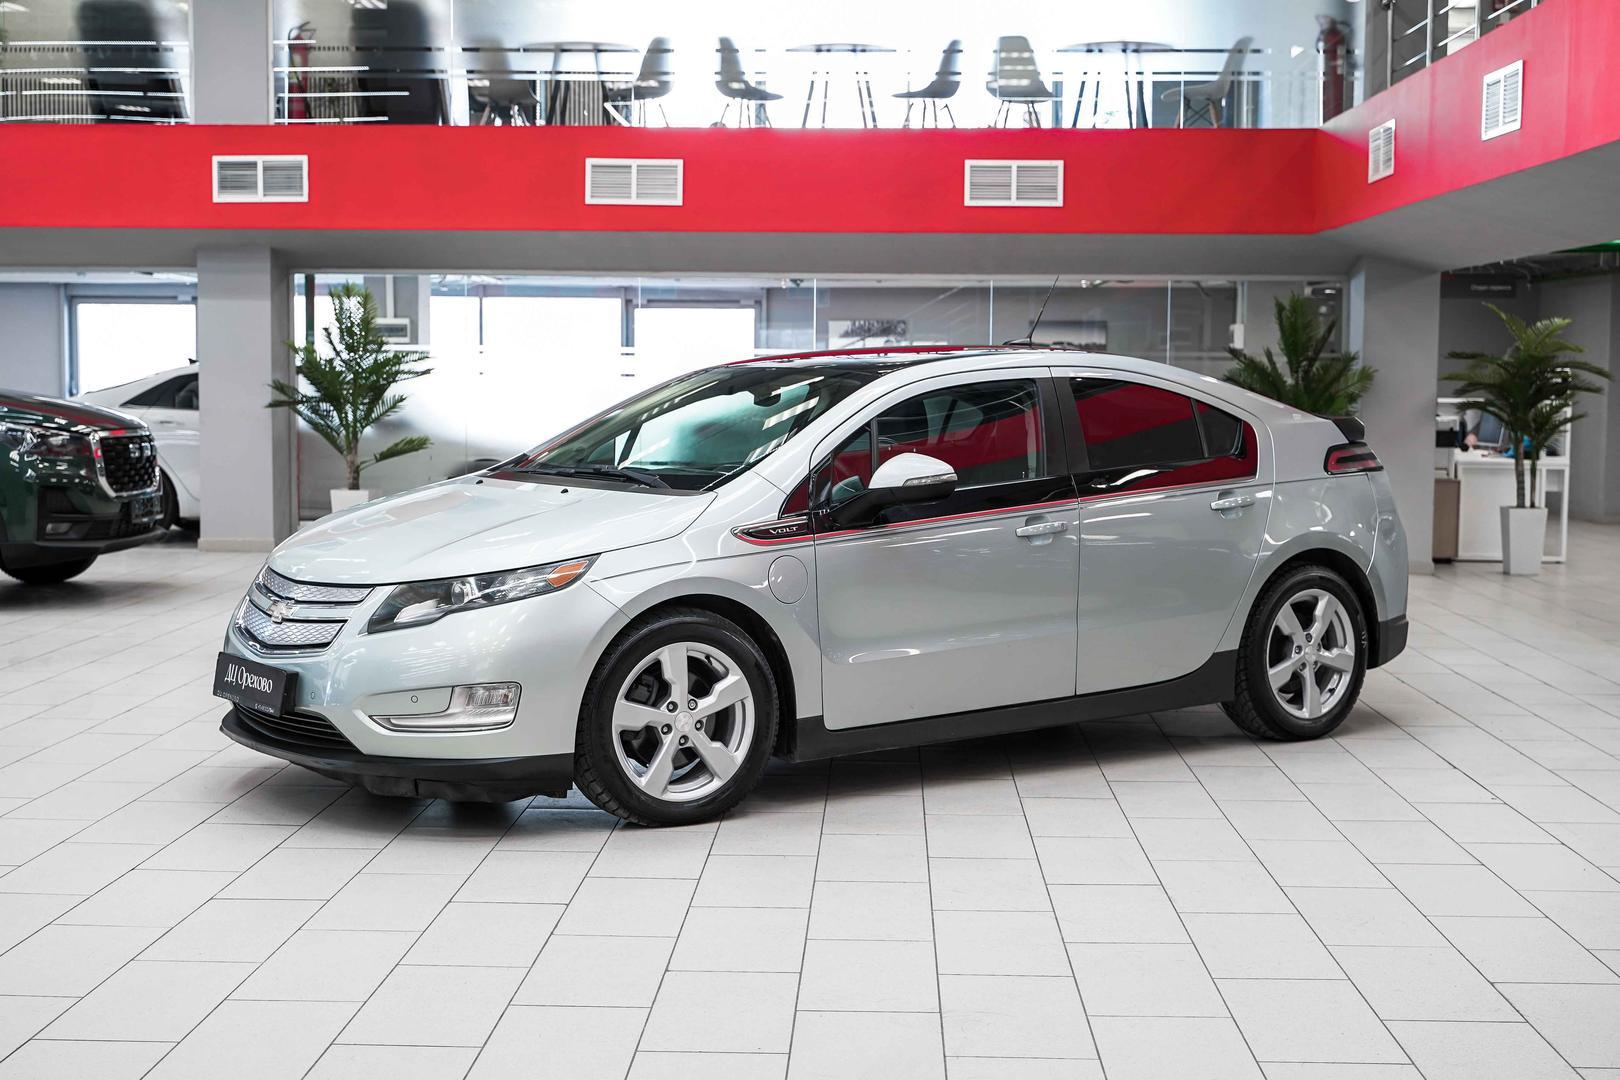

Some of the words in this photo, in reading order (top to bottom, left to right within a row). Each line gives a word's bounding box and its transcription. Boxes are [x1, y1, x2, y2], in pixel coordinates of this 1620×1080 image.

[769, 526, 799, 534] VOLT
[224, 663, 239, 686] ДЦ
[237, 666, 273, 693] Орехово
